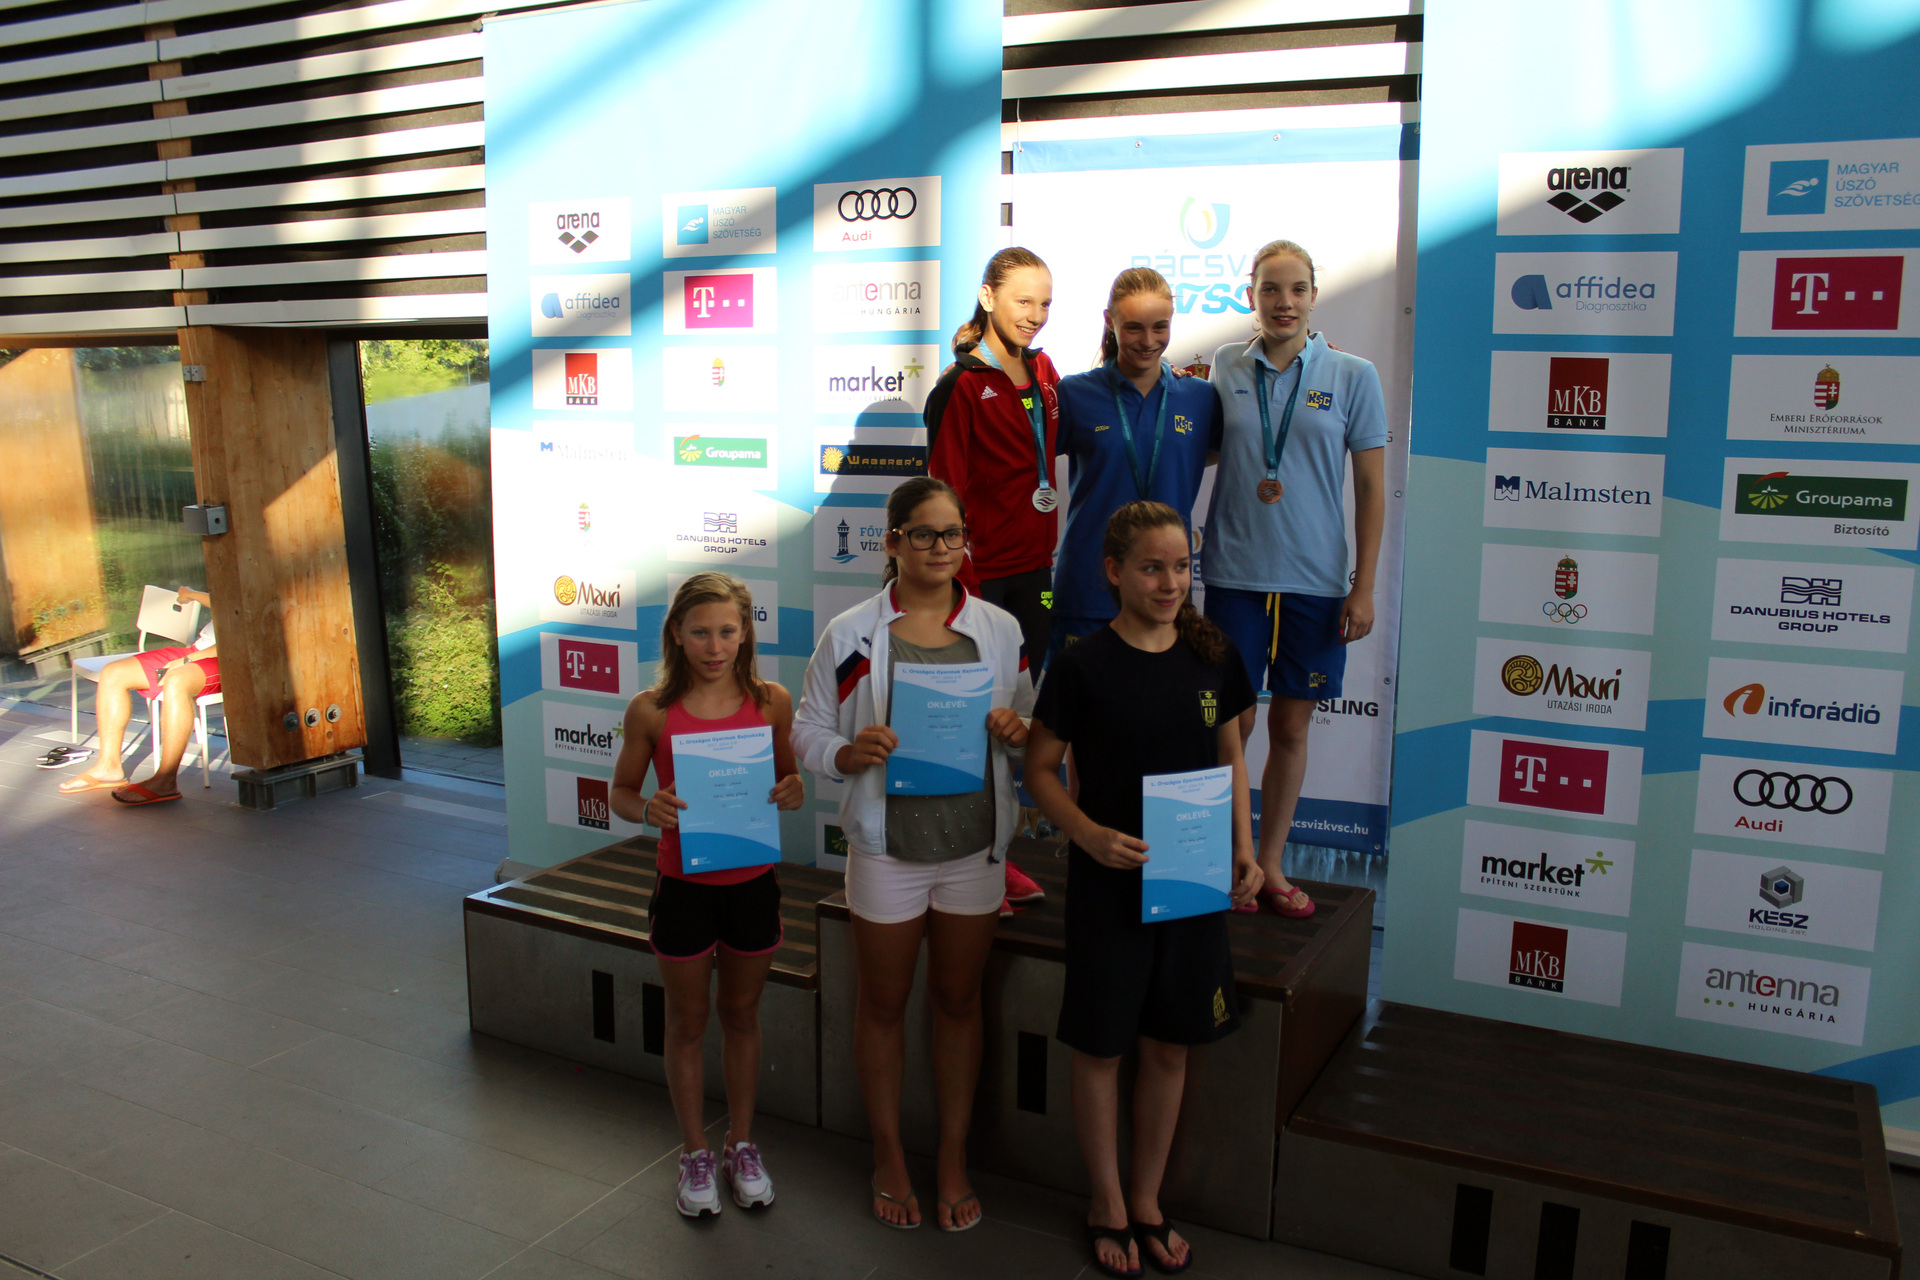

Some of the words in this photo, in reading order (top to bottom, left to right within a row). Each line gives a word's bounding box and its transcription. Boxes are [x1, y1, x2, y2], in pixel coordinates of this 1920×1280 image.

[1837, 162, 1899, 175] MAGYAR
[1547, 166, 1628, 190] arena
[1836, 177, 1876, 191] ÚSZÓ
[713, 205, 747, 215] MAGYAR
[557, 212, 600, 230] arena
[713, 217, 735, 226] ÚSZÓ
[713, 227, 762, 239] SZÖVETSÉG
[842, 230, 872, 242] Audi
[1556, 276, 1655, 299] affidea
[565, 293, 620, 309] affidea
[1575, 301, 1647, 313] Diagnosztika
[861, 305, 921, 315] HUNGÁRIA
[568, 373, 596, 395] MKB
[829, 366, 904, 392] market
[568, 397, 596, 405] BANK
[1553, 386, 1601, 415] MKB
[1553, 418, 1600, 427] BANK
[705, 446, 761, 461] Groupama
[1525, 481, 1651, 505] Malmsten
[1796, 490, 1893, 508] Groupama
[1834, 524, 1889, 536] Biztosító
[676, 534, 726, 544] DANUBIUS
[728, 537, 767, 546] HOTELS
[704, 546, 737, 554] GROUP
[577, 581, 620, 608] Mauri
[602, 609, 618, 618] IRODA
[1730, 605, 1819, 619] DANUBIUS
[1822, 611, 1891, 624] HOTELS
[1778, 621, 1839, 633] GROUP
[1542, 663, 1622, 701] Mauri
[927, 700, 968, 709] OKLEVÉL
[1314, 698, 1379, 717] SLING
[1547, 699, 1582, 712] UTAZÁSI
[1586, 703, 1612, 714] IRODA
[1768, 696, 1881, 725] inforádió
[1316, 716, 1331, 725] Life
[555, 724, 613, 749] market
[708, 766, 749, 778] OKLEVÉL
[580, 797, 607, 819] MKB
[581, 817, 607, 829] BANK
[1175, 810, 1212, 822] OKLEVÉL
[1734, 816, 1783, 832] Audi
[1481, 853, 1585, 887] market
[1480, 875, 1518, 888] ÉPÍTENI
[1524, 884, 1581, 898] SZERETÜNK
[1748, 924, 1787, 934] HOLDING
[1515, 950, 1560, 979] MKB
[1515, 976, 1558, 989] BANK
[1705, 967, 1839, 1007] antenna
[1748, 1002, 1836, 1024] HUNGÁRIA
